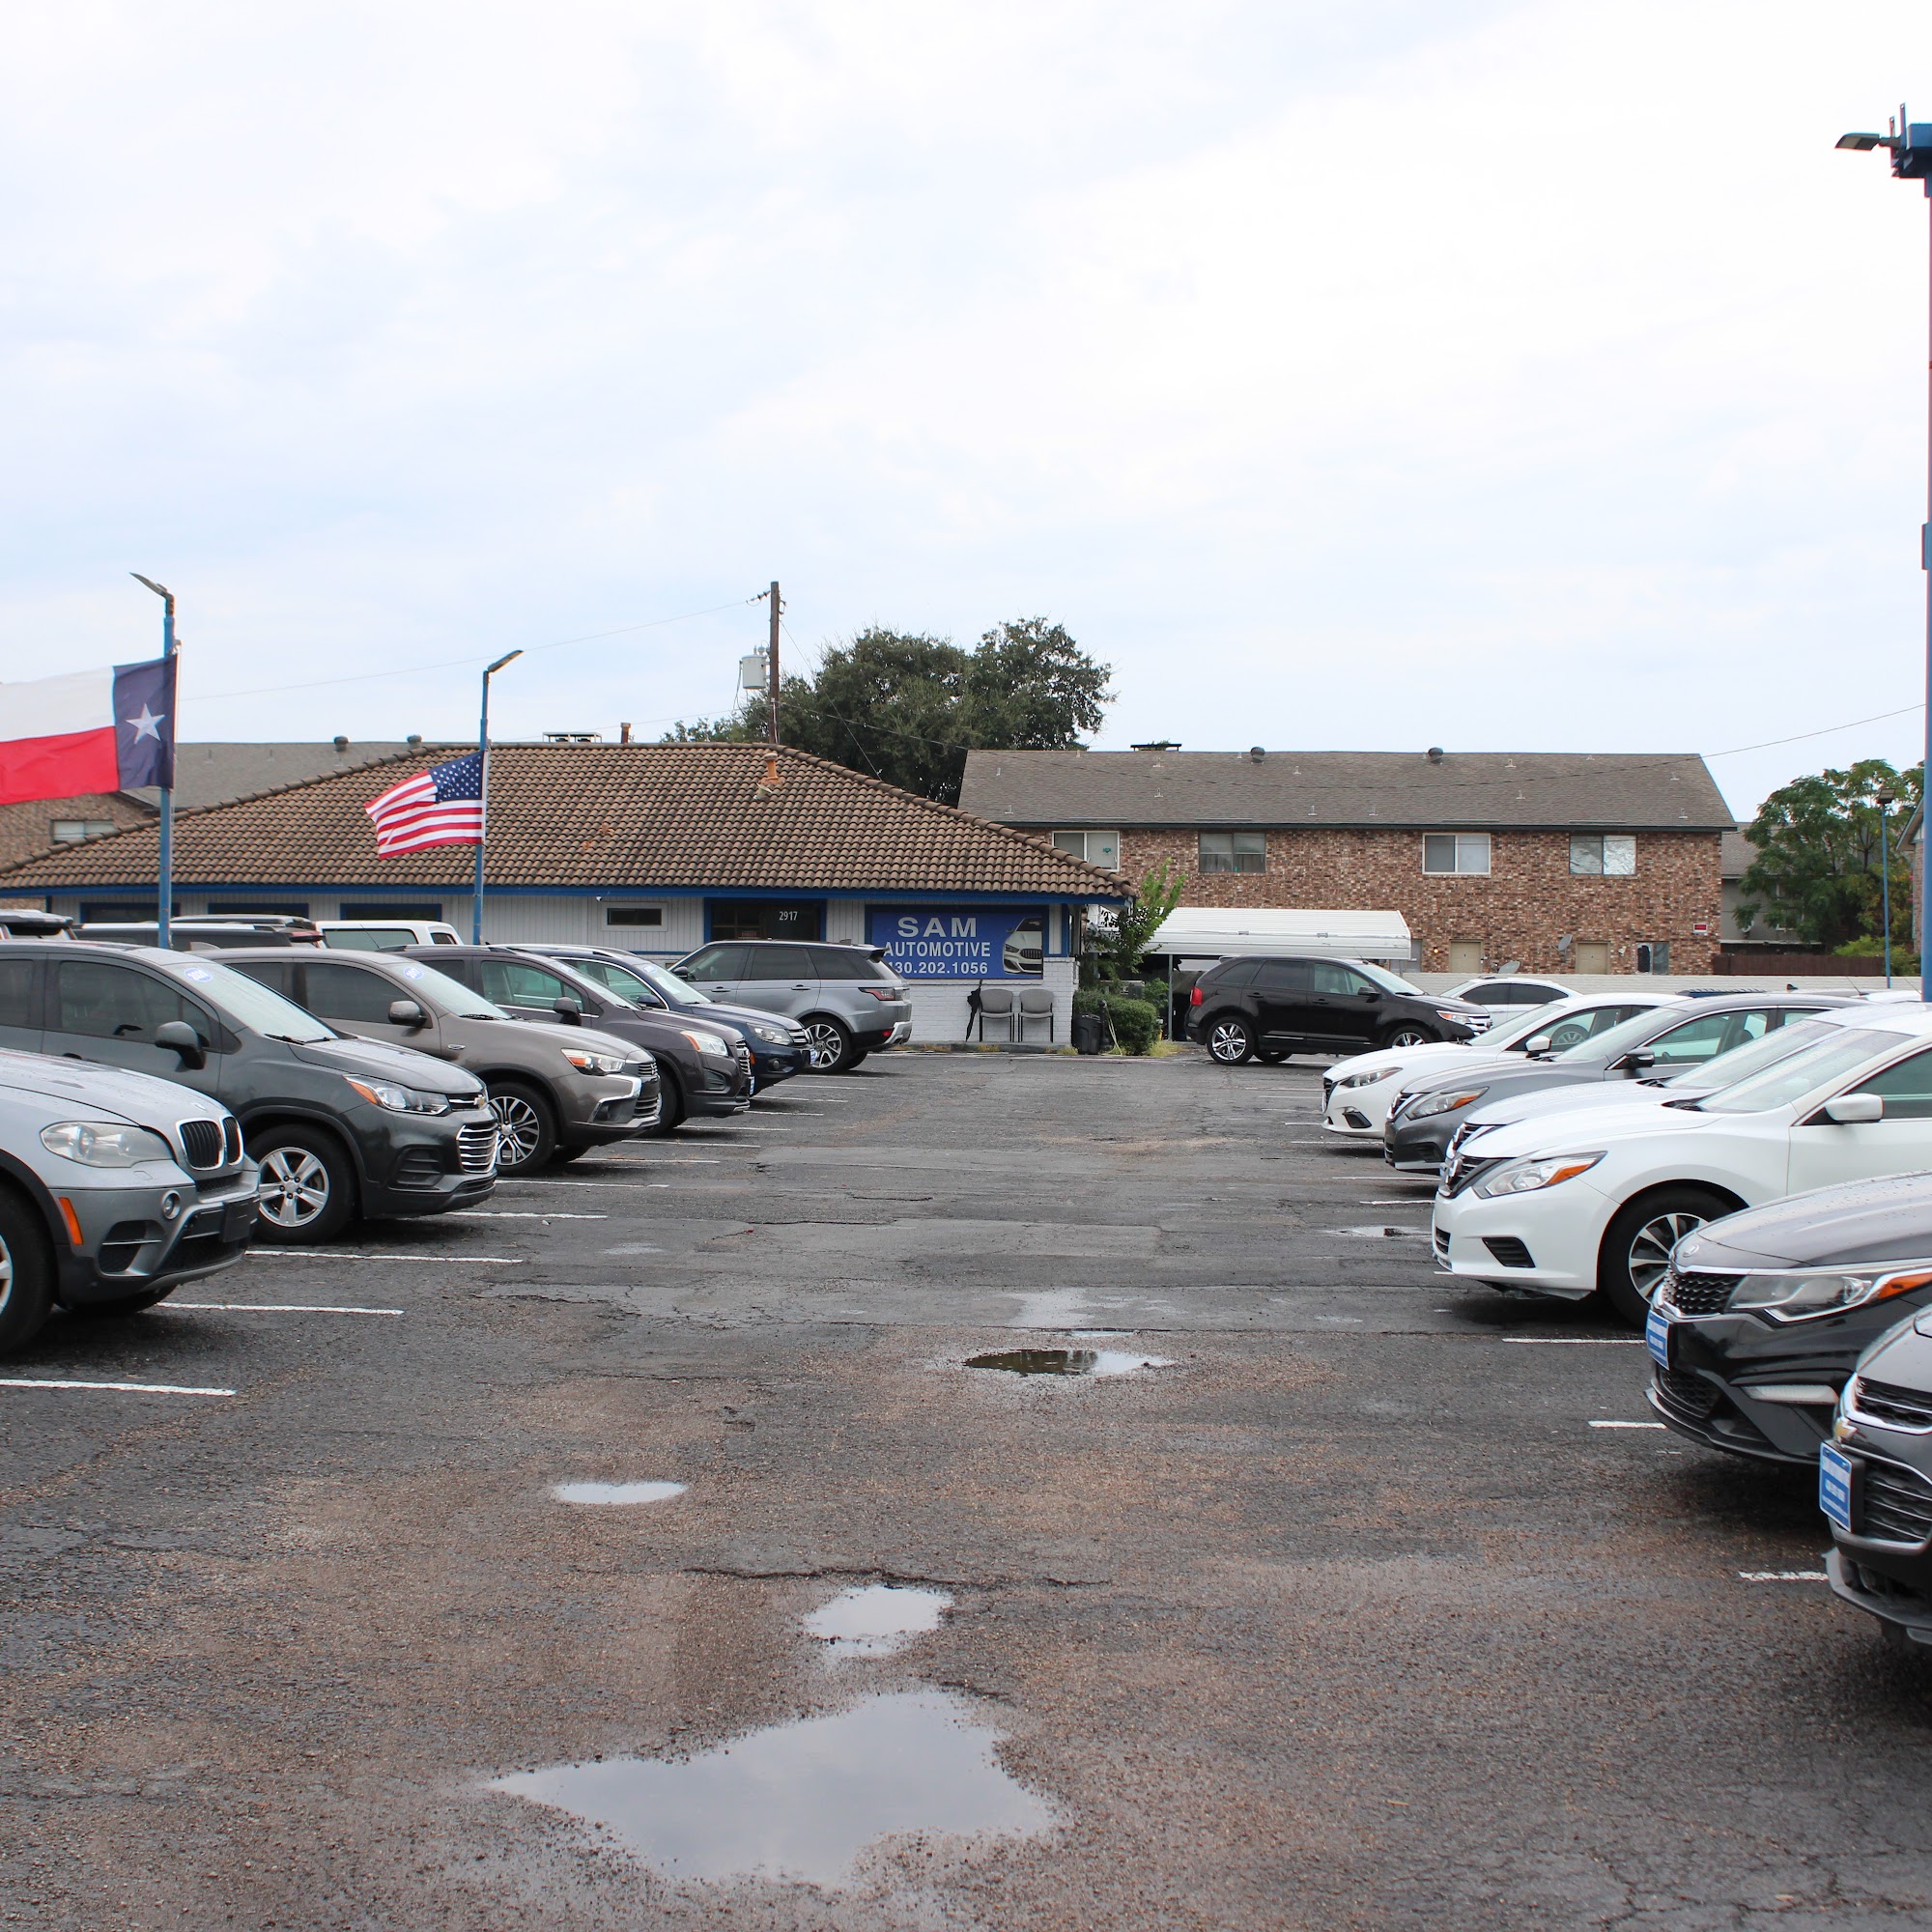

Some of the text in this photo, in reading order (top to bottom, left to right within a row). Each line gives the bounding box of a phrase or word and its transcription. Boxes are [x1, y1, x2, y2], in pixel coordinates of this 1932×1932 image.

[779, 911, 798, 922] 2917
[897, 917, 978, 938] SAM
[884, 942, 991, 957] AUTOMOTIVE
